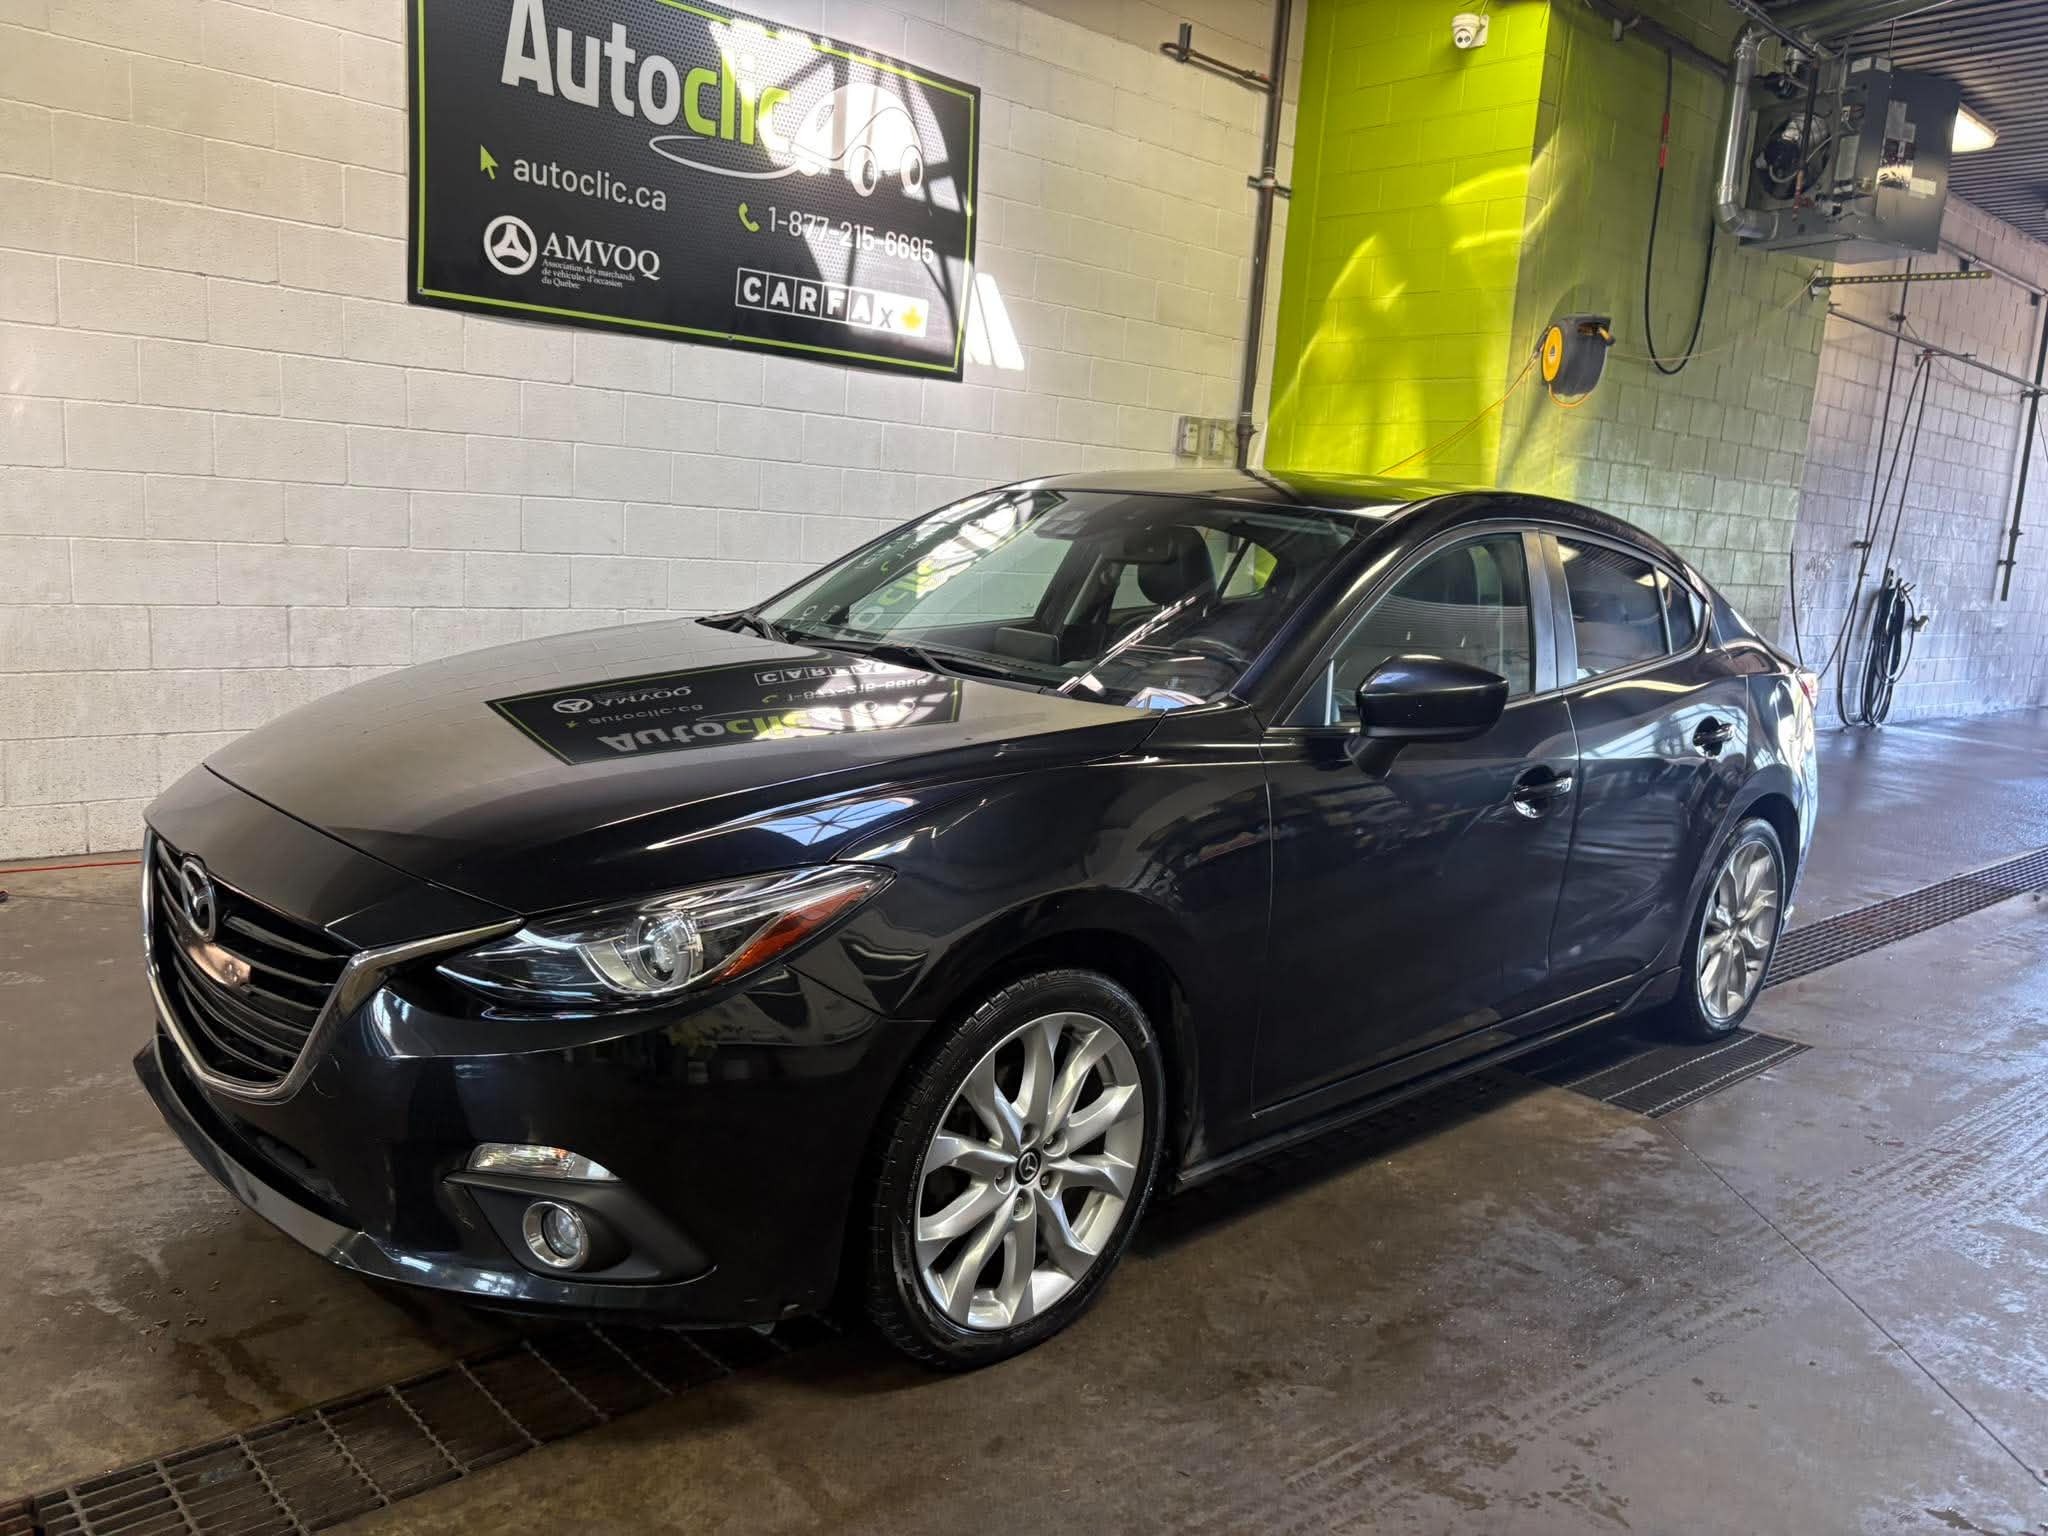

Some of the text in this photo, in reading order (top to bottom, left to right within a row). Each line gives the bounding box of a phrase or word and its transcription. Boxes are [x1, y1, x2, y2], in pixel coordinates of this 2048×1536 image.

[501, 0, 791, 152] Autoclic
[513, 159, 667, 211] autoclic.ca
[541, 232, 661, 280] AMVOQ
[768, 206, 934, 264] 1-877-215-6695
